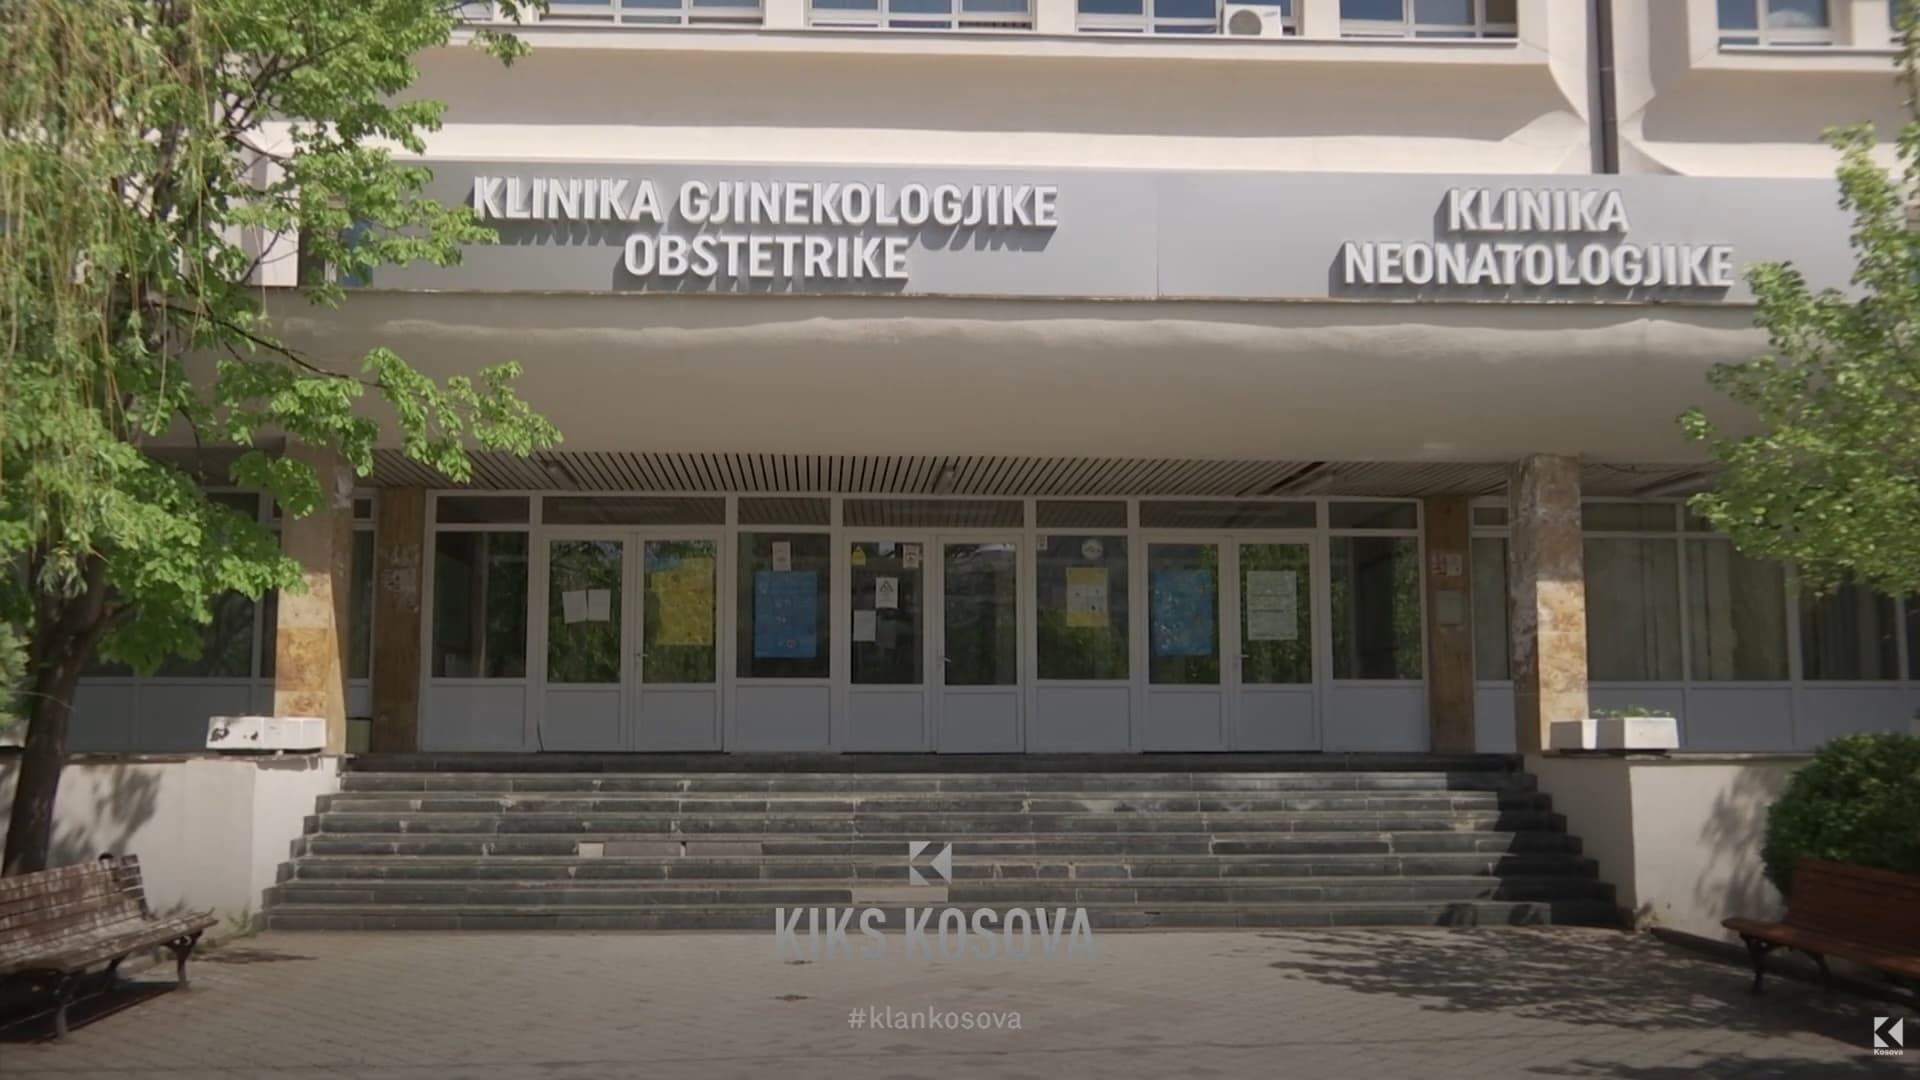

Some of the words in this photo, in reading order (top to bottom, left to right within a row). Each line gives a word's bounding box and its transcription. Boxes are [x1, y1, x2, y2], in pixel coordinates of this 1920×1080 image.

[473, 176, 663, 222] KLINIKA
[679, 180, 1059, 228] GJINEKOLOGJIKE
[1447, 188, 1629, 232] KLINIKA
[624, 234, 909, 280] OBSTETRIKE
[1343, 242, 1735, 287] NEONATOLOGJIKE
